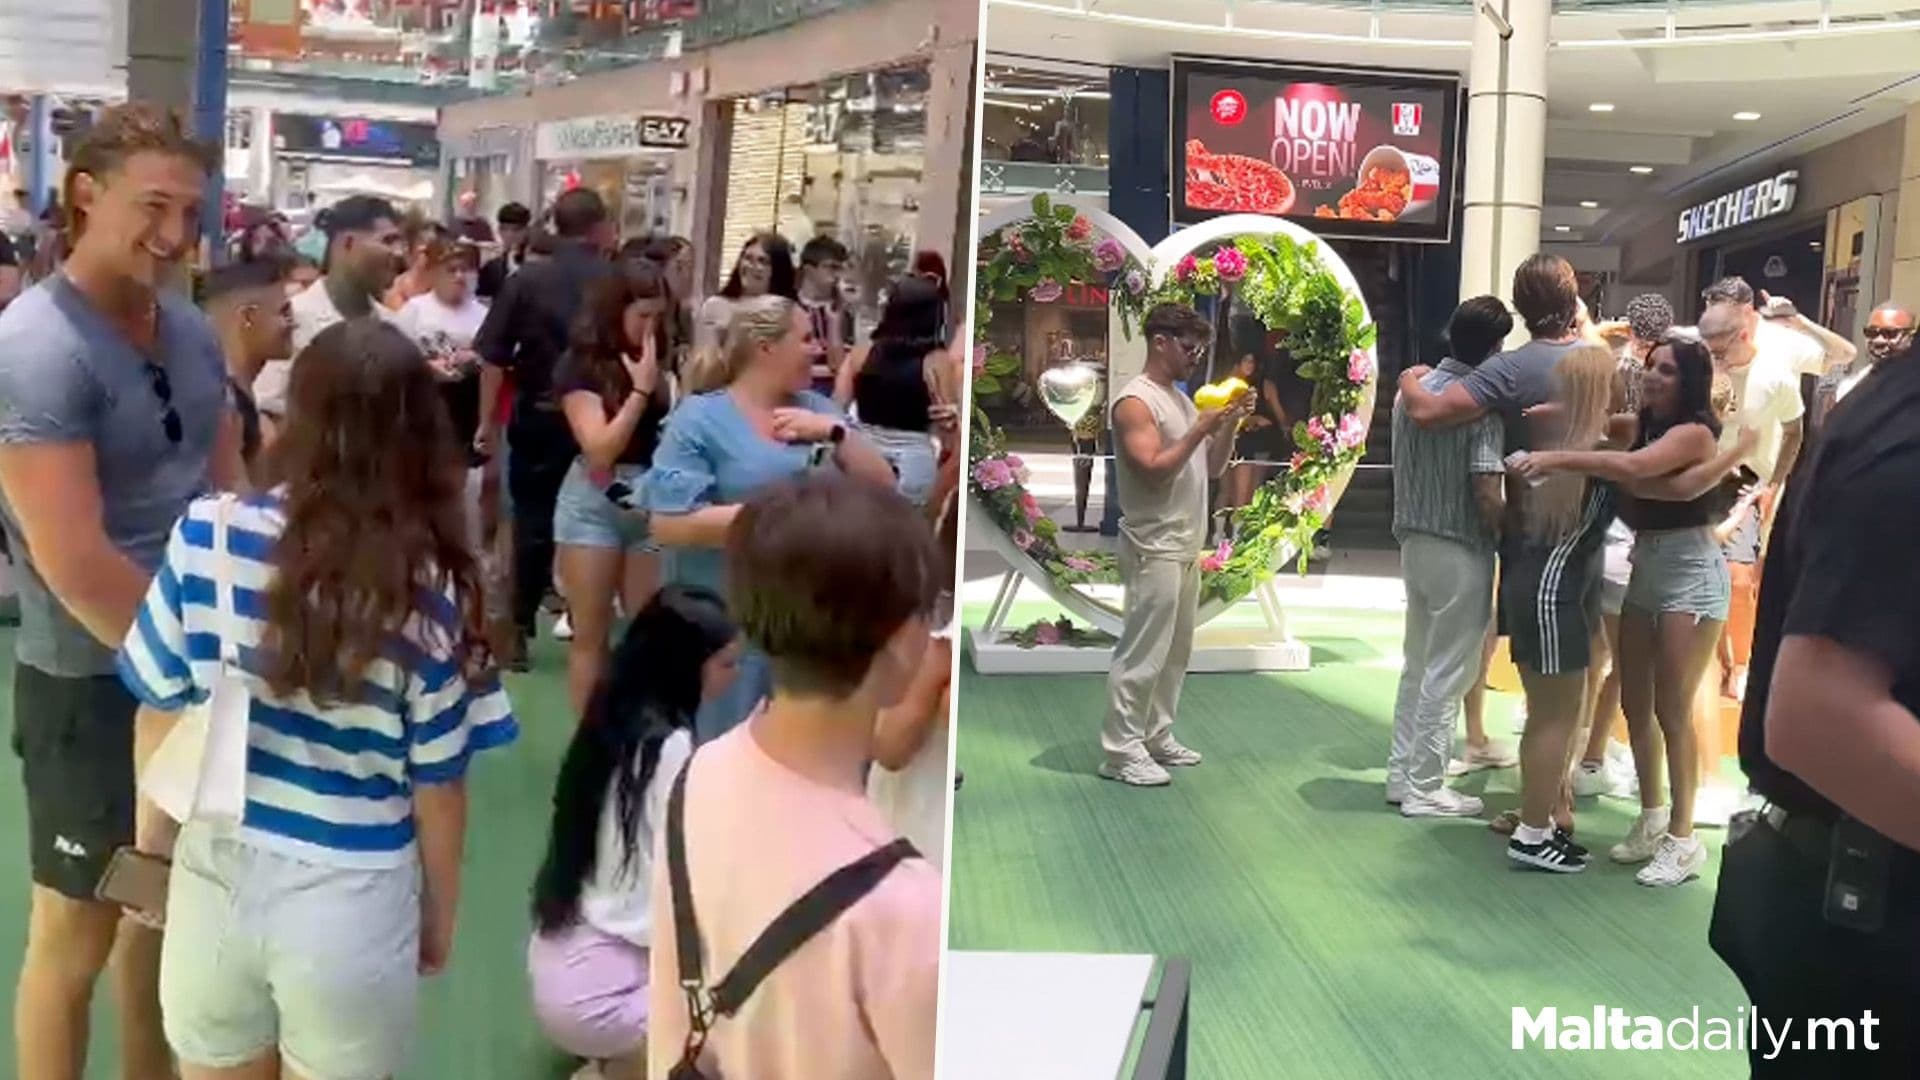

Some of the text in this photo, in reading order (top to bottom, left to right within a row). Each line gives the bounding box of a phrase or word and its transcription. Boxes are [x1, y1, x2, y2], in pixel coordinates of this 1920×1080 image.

[1275, 97, 1361, 142] NOW
[1271, 136, 1357, 177] OPEN!
[1676, 170, 1799, 243] SKECHERS
